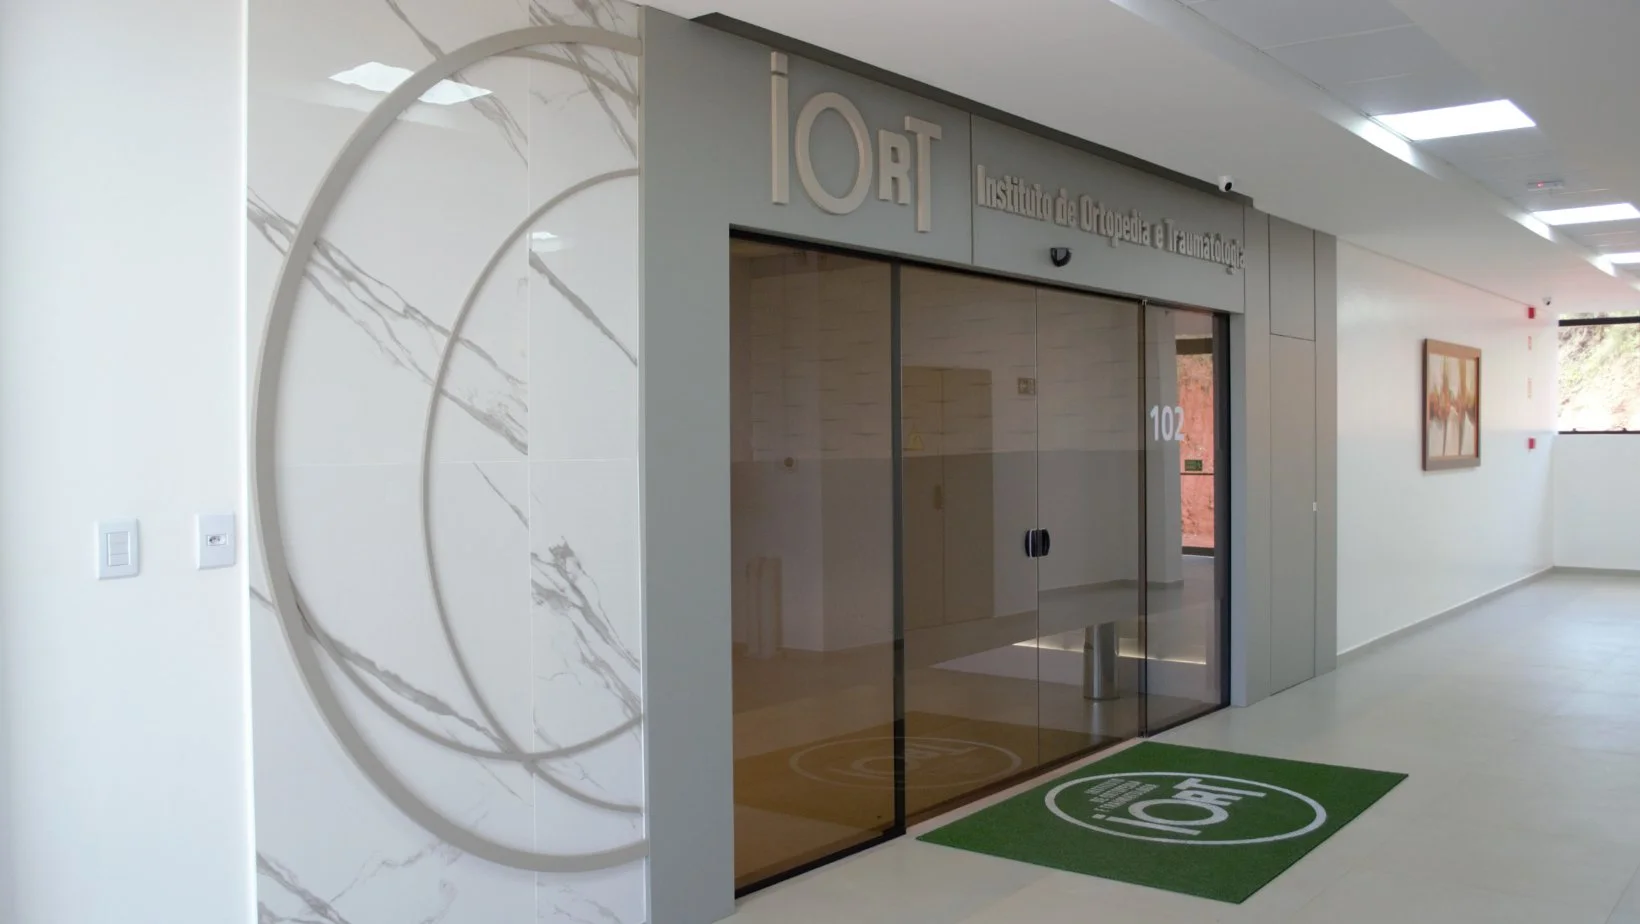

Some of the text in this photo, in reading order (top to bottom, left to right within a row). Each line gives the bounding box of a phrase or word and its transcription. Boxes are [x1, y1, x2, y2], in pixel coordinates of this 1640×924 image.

[977, 164, 1246, 275] Instituto de Ortopedia e Traumatologia
[1150, 405, 1185, 441] 102
